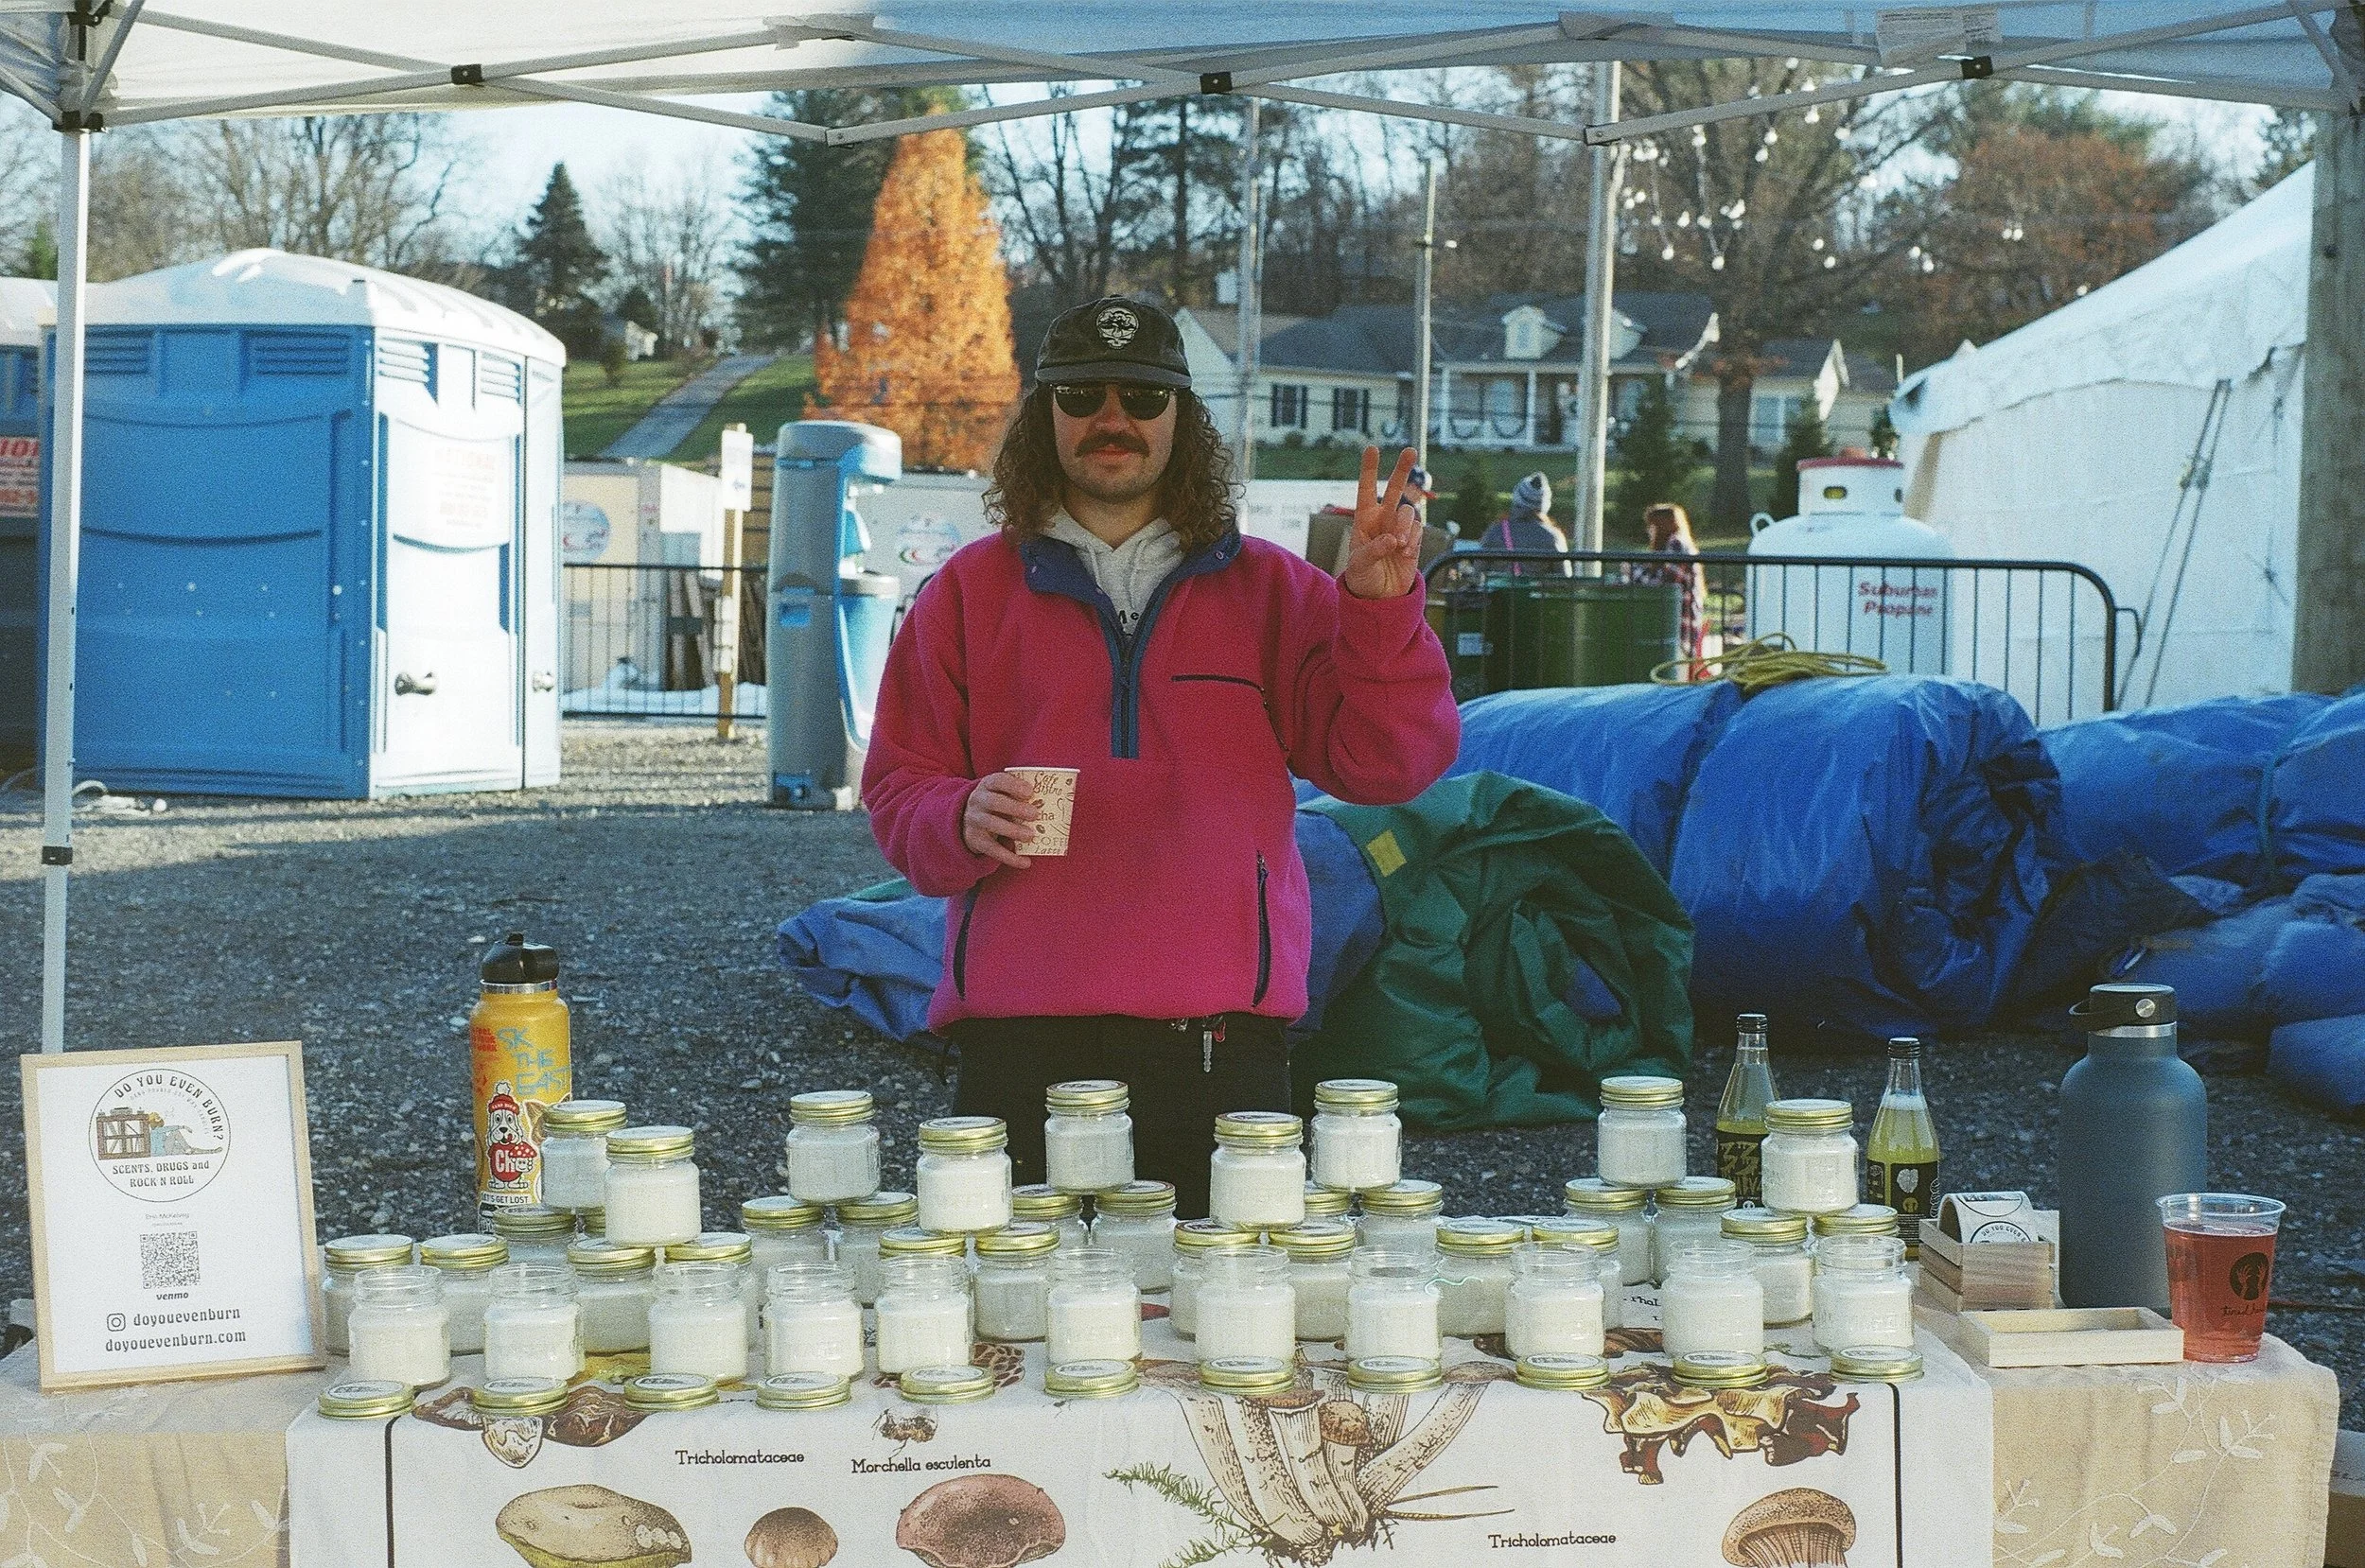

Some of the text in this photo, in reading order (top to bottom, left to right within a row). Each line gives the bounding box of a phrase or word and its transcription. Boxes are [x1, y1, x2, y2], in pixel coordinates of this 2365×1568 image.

[114, 1074, 224, 1141] DO YOU EVEN BURN?
[156, 1161, 189, 1173] DRUGS
[192, 1160, 209, 1170] and
[169, 1176, 194, 1185] ROLL
[510, 1195, 529, 1204] LOST
[156, 1292, 189, 1300] venmo
[133, 1308, 240, 1327] doyouevenburn
[105, 1331, 246, 1352] doyouevenburn.com
[674, 1449, 804, 1465] Tricholomataceae
[851, 1454, 991, 1473] Morchella esculenta
[1488, 1531, 1616, 1548] Tricholomataceae
